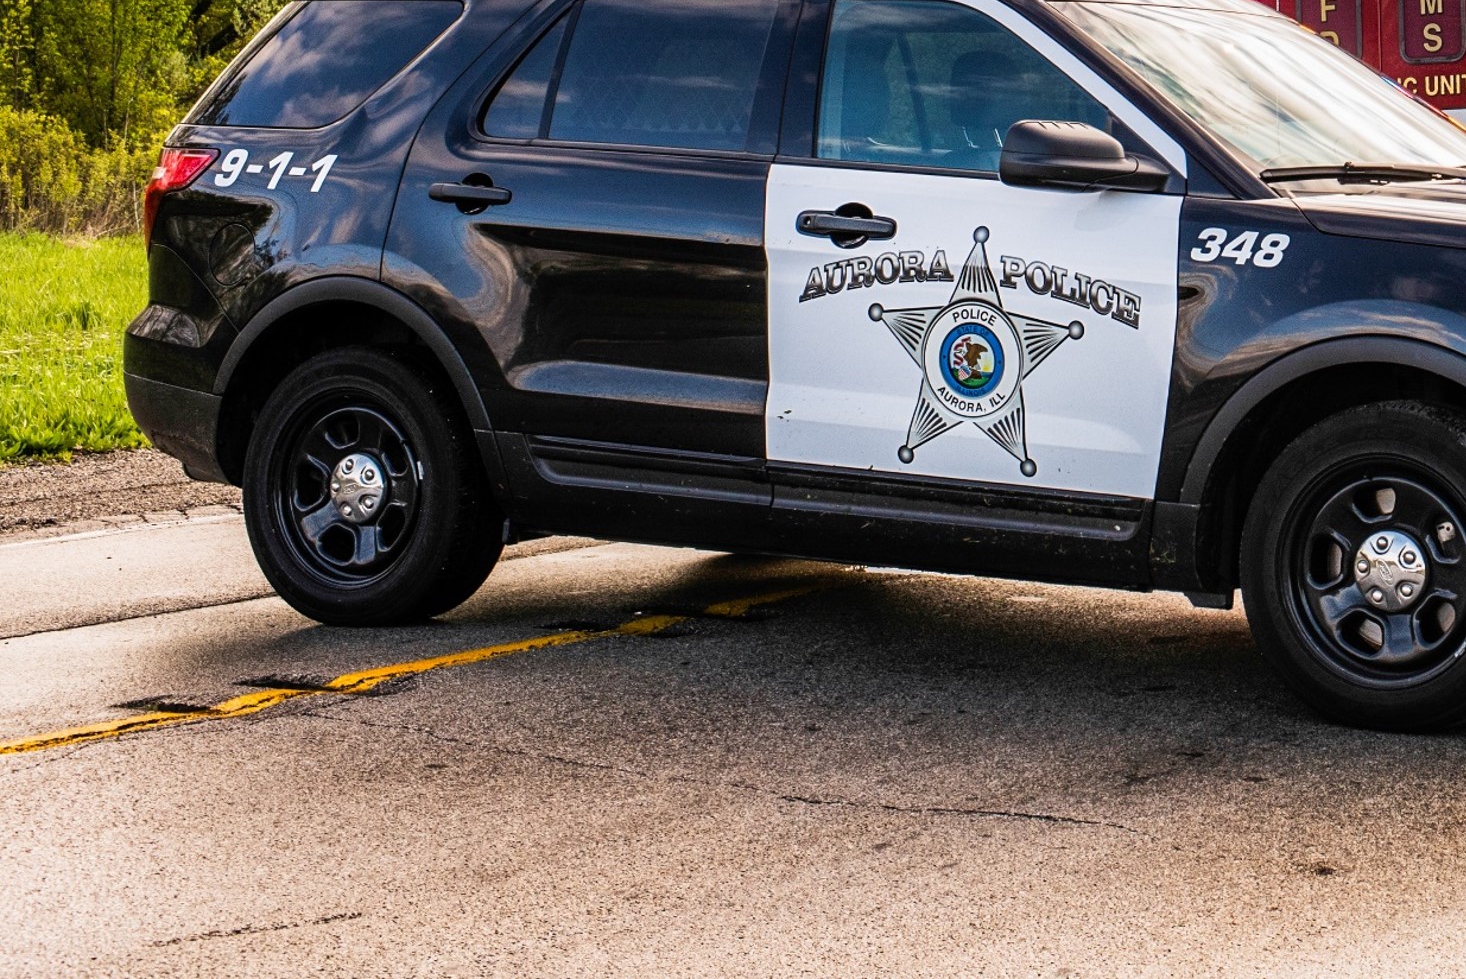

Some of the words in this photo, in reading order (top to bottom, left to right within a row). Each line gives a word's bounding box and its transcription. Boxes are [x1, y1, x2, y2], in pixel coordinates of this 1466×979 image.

[214, 148, 338, 193] 9-1-1
[1190, 227, 1291, 268] 348
[798, 249, 954, 303] AURORA
[999, 254, 1141, 329] POLICE
[952, 308, 997, 326] POLICE
[989, 392, 1006, 408] ILL
